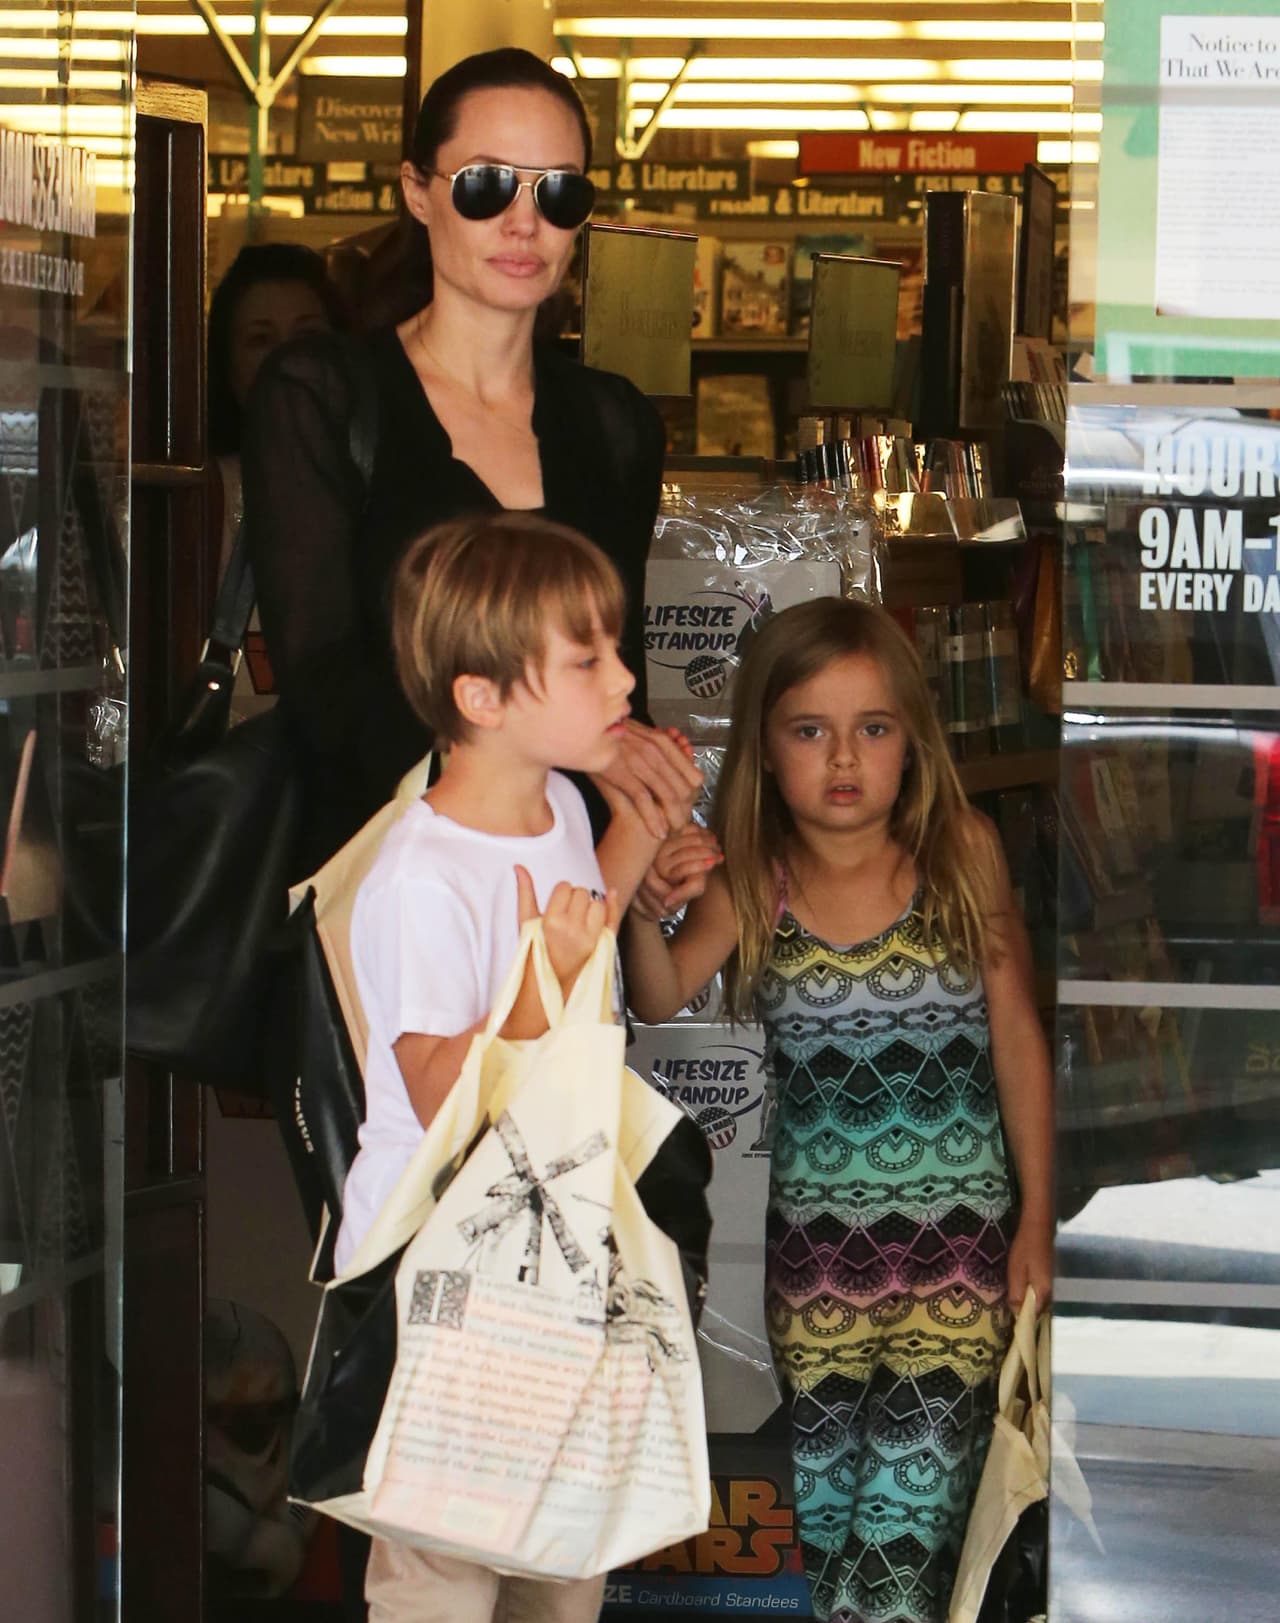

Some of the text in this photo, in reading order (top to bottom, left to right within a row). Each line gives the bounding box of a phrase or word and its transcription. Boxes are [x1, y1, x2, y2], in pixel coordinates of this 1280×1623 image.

[1190, 33, 1277, 53] Notice to
[1164, 59, 1209, 78] That
[1216, 60, 1245, 79] We
[316, 96, 403, 118] Discover
[316, 121, 402, 143] New Wri
[858, 140, 977, 169] New Fiction
[220, 159, 315, 188] Litature
[616, 162, 635, 191] &
[641, 163, 738, 191] Literature
[775, 188, 793, 215] &
[797, 188, 884, 217] Literature
[1142, 434, 1280, 498] HOUR
[1139, 572, 1234, 612] EVERY
[643, 605, 737, 627] LIFESIZE
[643, 631, 737, 651] STANDUP
[652, 1058, 749, 1082] LIFESIZE
[709, 1479, 794, 1526] AR
[615, 1527, 794, 1574] ARS
[603, 1584, 800, 1610] ZE Cardboard Standees
